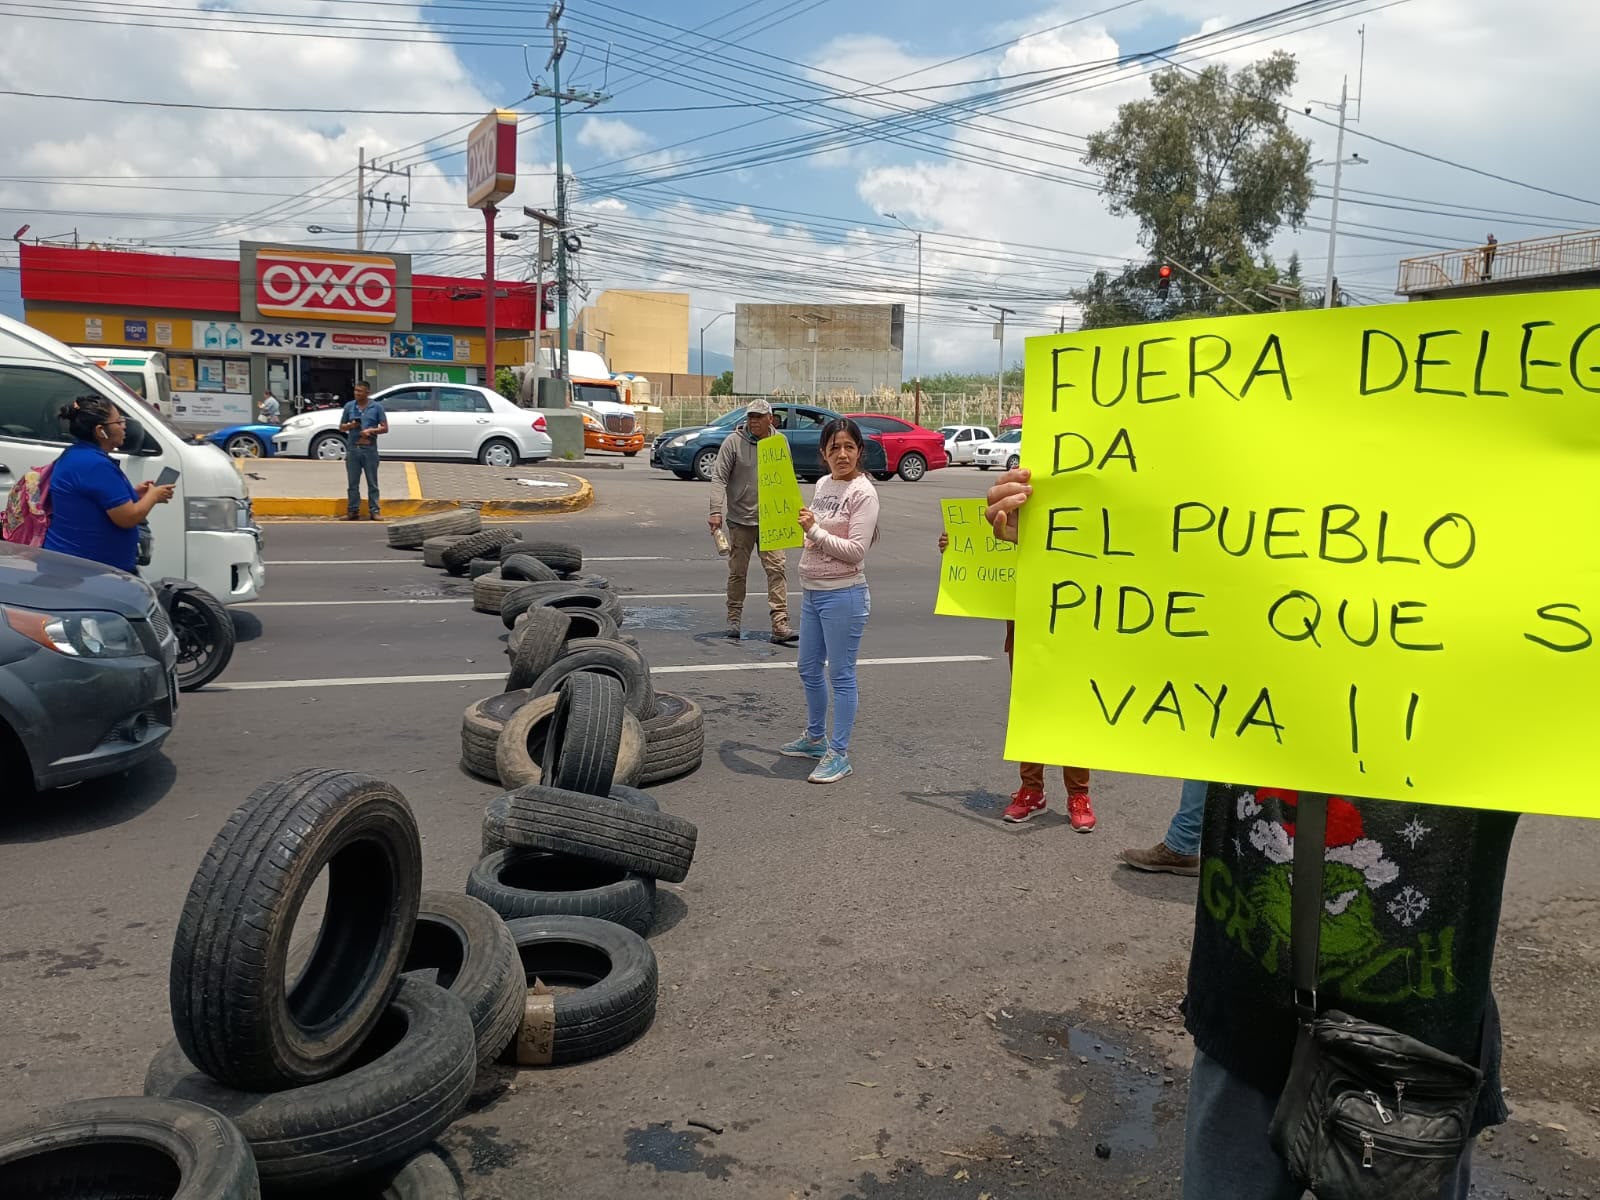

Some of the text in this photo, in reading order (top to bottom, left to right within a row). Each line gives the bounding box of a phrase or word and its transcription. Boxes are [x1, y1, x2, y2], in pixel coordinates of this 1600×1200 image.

[262, 264, 392, 308] OXXO
[1051, 334, 1292, 413] FUERA
[1051, 428, 1137, 476] DA
[773, 498, 791, 515] LA
[948, 505, 970, 524] EL
[954, 536, 975, 556] LA
[1045, 502, 1476, 569] EL PUEBLO
[948, 565, 967, 582] NO
[1049, 581, 1209, 638] PIDE
[1268, 590, 1444, 651] QUE
[1090, 679, 1285, 745] VAYA
